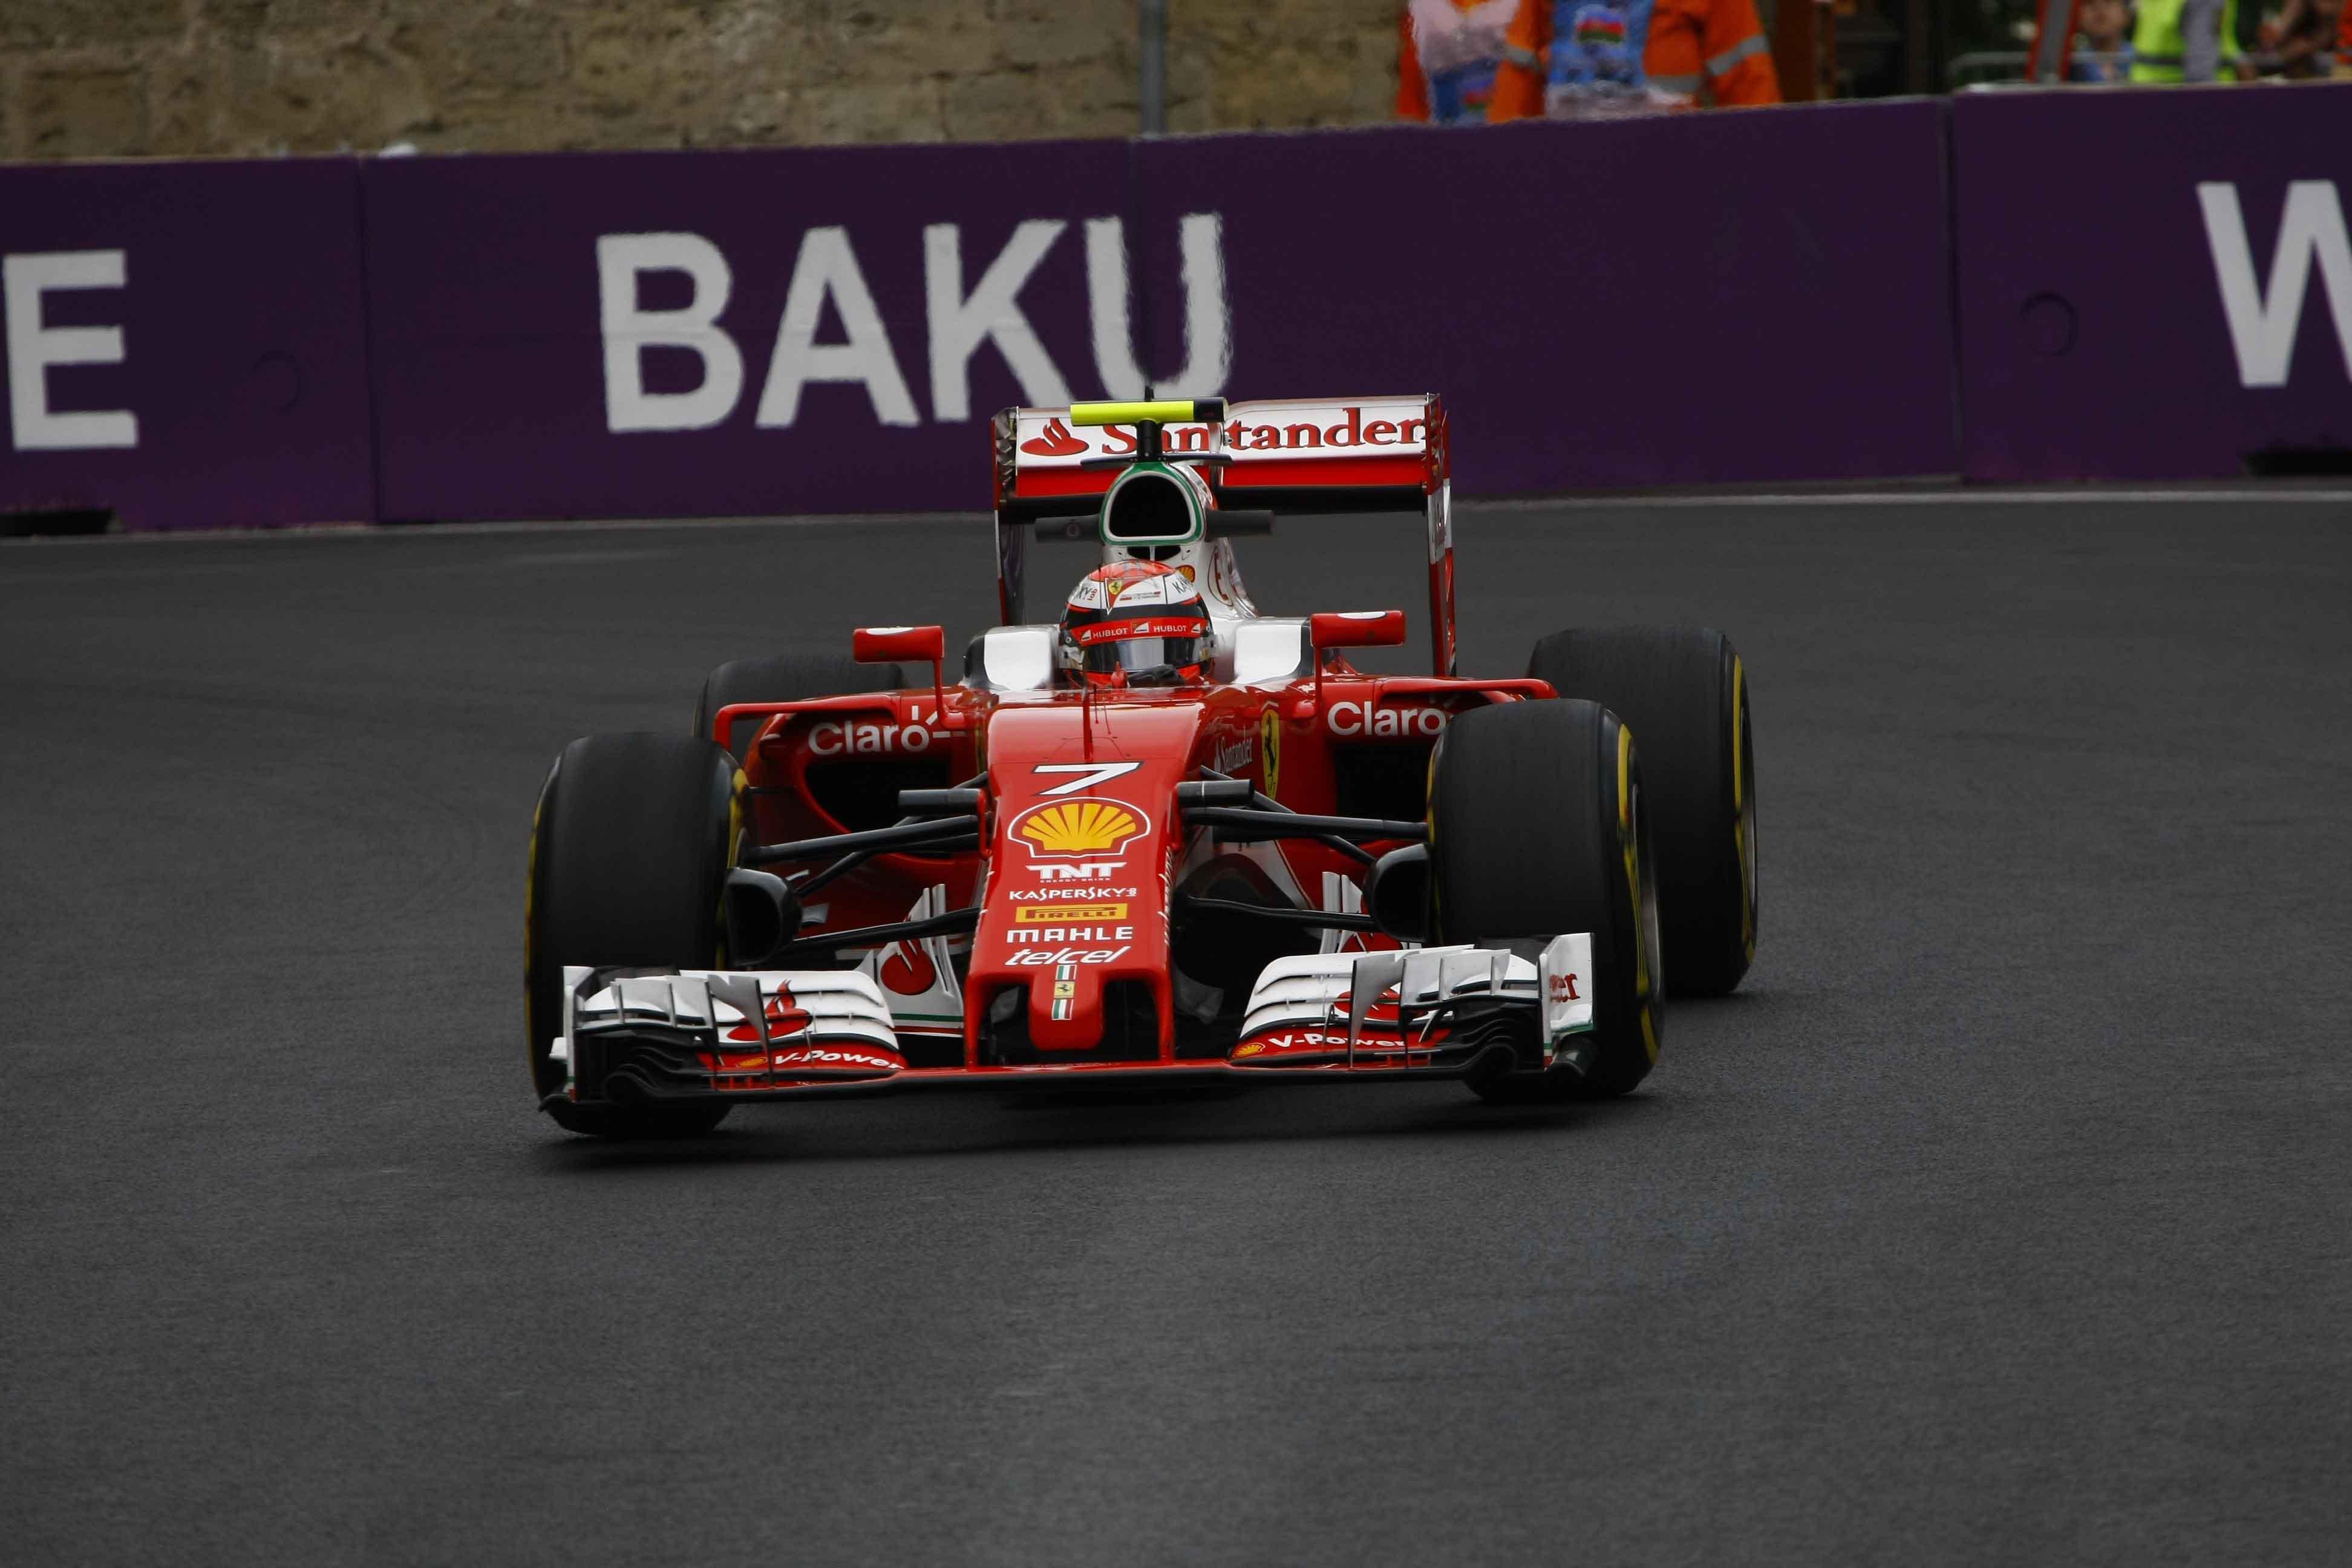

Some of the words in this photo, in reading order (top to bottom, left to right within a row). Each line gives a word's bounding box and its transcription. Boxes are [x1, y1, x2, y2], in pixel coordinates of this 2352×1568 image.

[596, 210, 1232, 433] BAKU
[1093, 627, 1128, 639] HUBLOT
[1153, 624, 1187, 633] HUBLOT
[1327, 701, 1447, 736] Claro
[808, 720, 930, 756] Claro
[1031, 762, 1144, 795] 7
[1025, 861, 1128, 879] TNT
[1025, 906, 1119, 920] PIRELLI
[1006, 926, 1134, 944] MAHLE
[1004, 946, 1132, 965] telcel
[774, 1050, 905, 1070] V-Power
